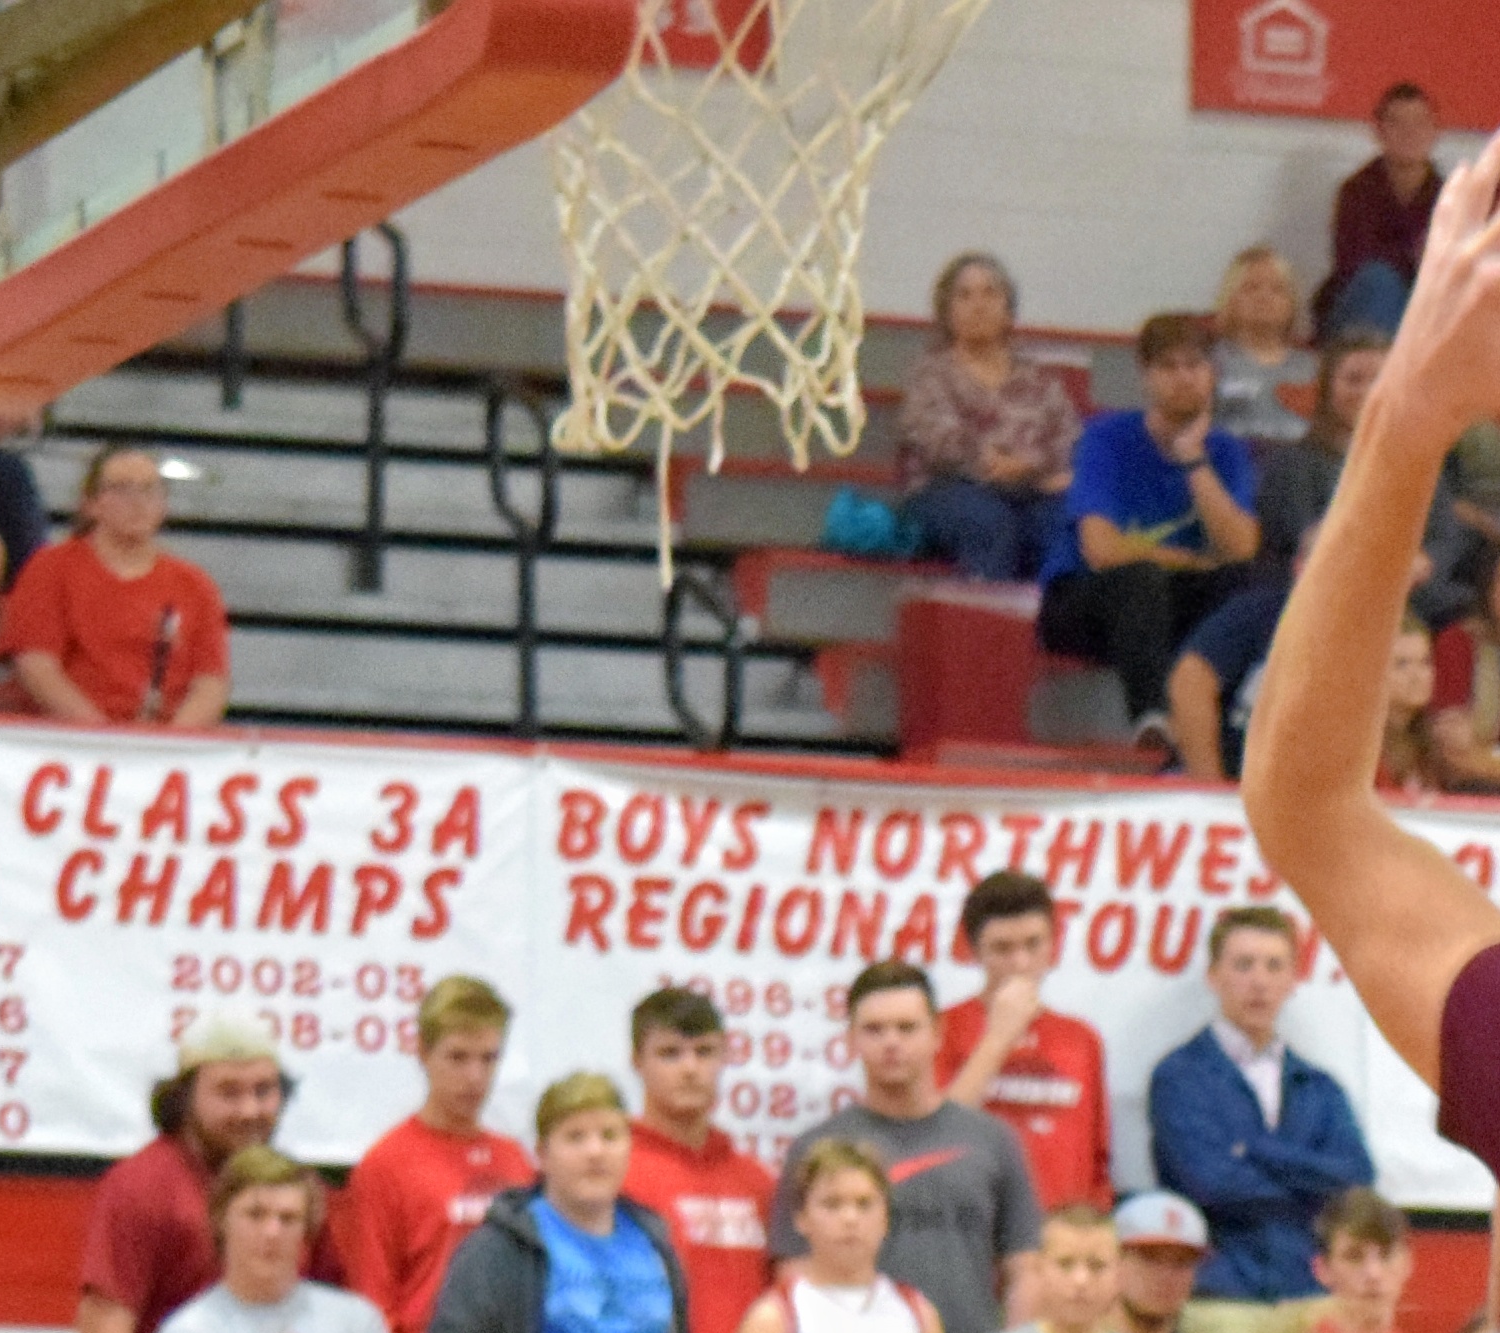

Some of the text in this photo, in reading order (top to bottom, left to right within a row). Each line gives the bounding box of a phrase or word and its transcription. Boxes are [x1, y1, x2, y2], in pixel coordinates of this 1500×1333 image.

[21, 762, 318, 847] CLASS
[370, 782, 481, 858] 3A
[557, 789, 772, 871] BOYS
[55, 849, 462, 940] CHAMPS
[170, 953, 426, 1003] 2002-03
